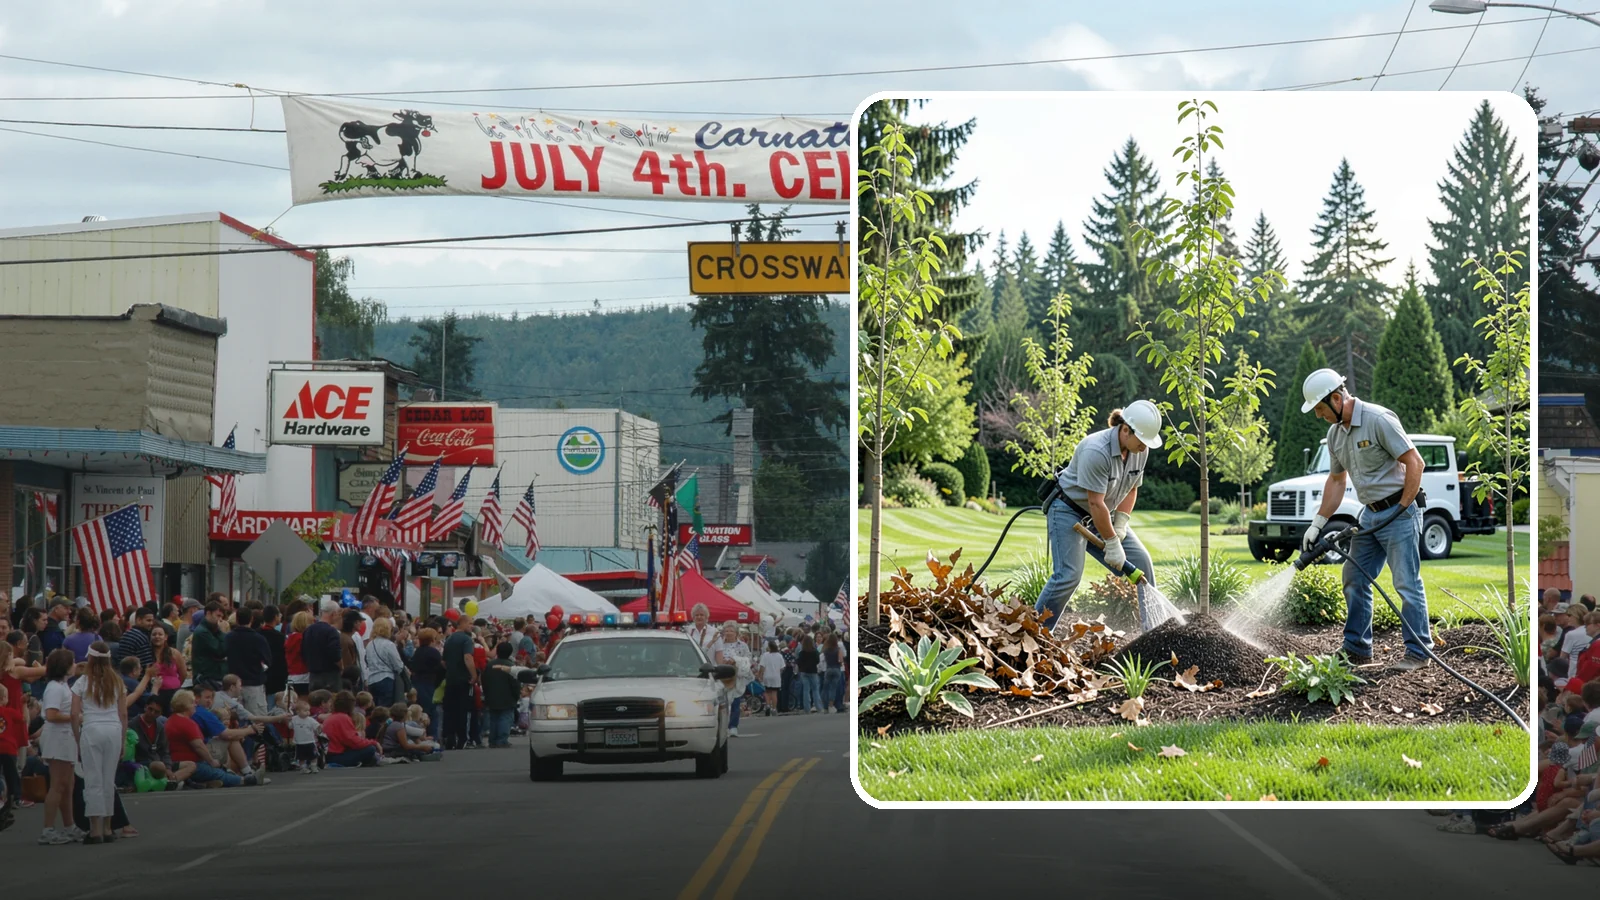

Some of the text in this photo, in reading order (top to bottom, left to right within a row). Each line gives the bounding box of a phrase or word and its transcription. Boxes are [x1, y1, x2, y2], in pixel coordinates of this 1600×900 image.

[481, 141, 605, 192] JULY
[632, 149, 746, 198] 4th.
[697, 254, 850, 280] CROSSWA
[282, 380, 374, 420] ACE
[405, 409, 452, 422] CEDAR
[283, 421, 371, 436] Hardware
[83, 485, 155, 495] St. Vincent de Paul
[688, 526, 741, 535] CRNATION
[699, 535, 730, 543] GLASS
